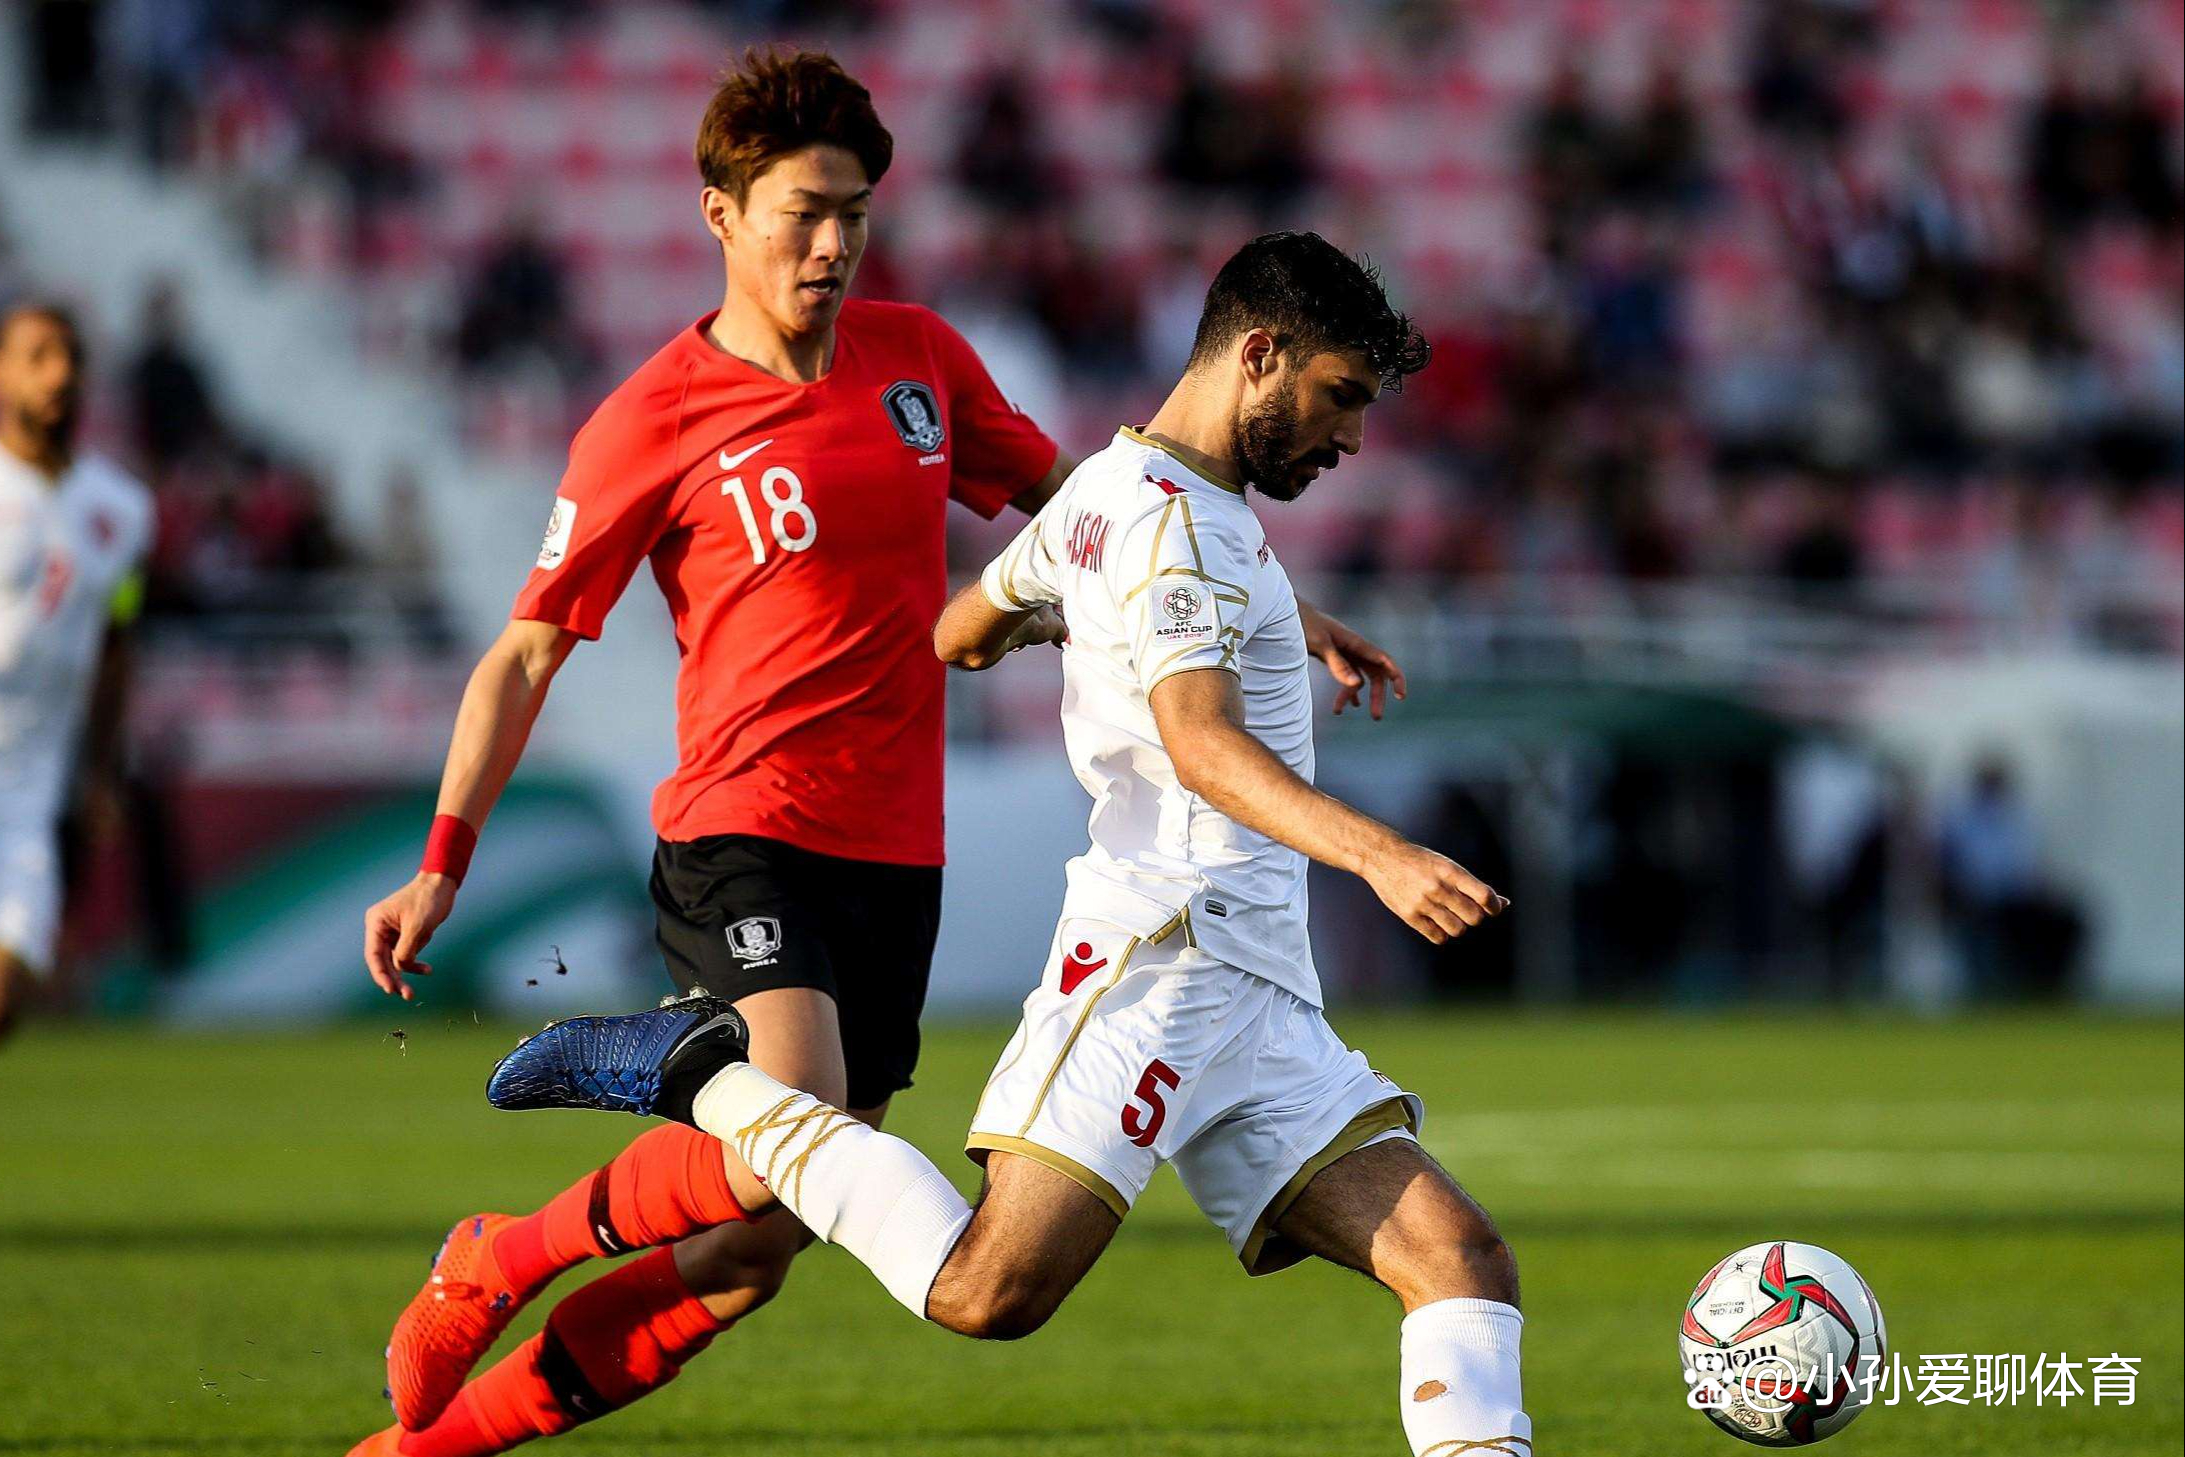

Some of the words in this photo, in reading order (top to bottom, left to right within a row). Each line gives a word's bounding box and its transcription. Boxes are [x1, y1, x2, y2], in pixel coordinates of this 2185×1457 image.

[721, 466, 818, 565] 18
[1156, 627, 1188, 636] ASIAN
[1191, 625, 1213, 633] CUP
[1121, 1058, 1181, 1148] 5
